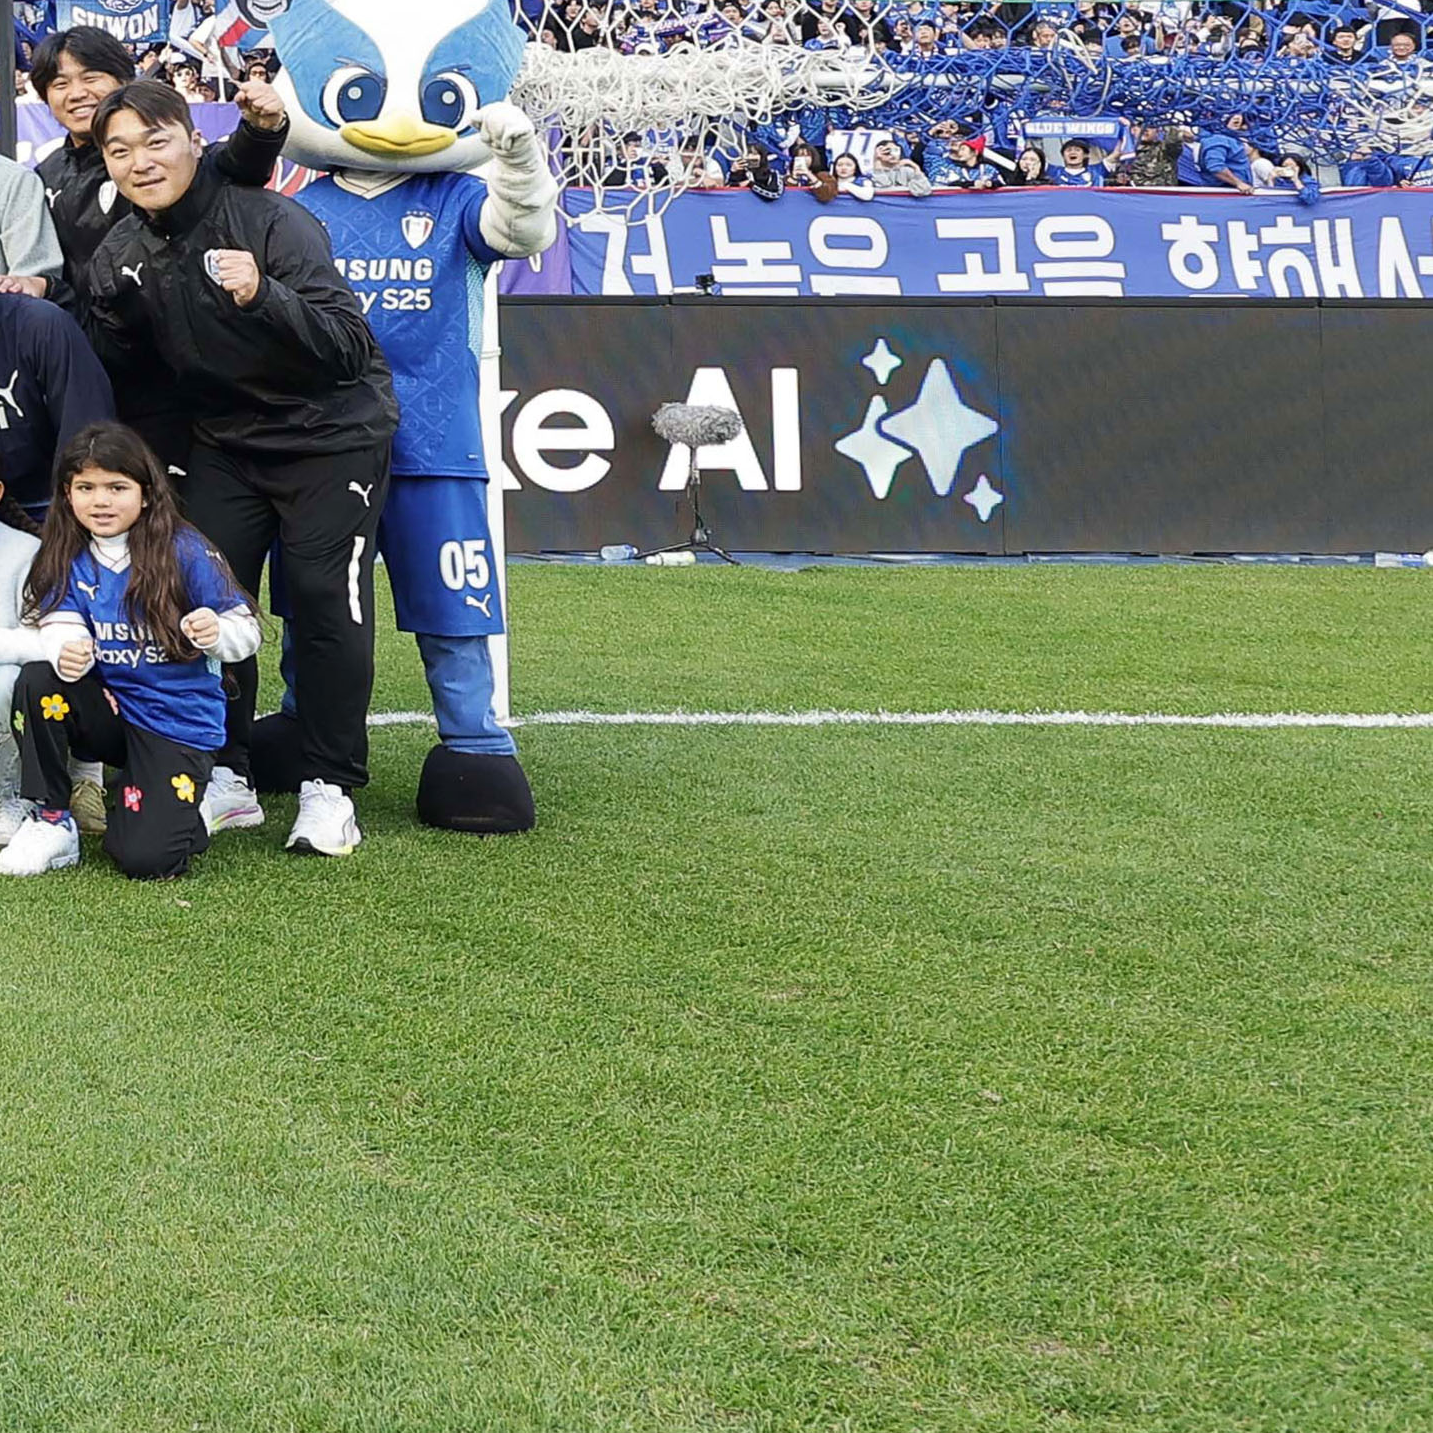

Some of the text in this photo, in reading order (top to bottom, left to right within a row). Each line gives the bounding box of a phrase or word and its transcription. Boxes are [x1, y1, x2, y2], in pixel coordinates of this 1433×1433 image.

[381, 287, 432, 312] S25
[656, 367, 803, 493] AI
[439, 539, 488, 592] 05
